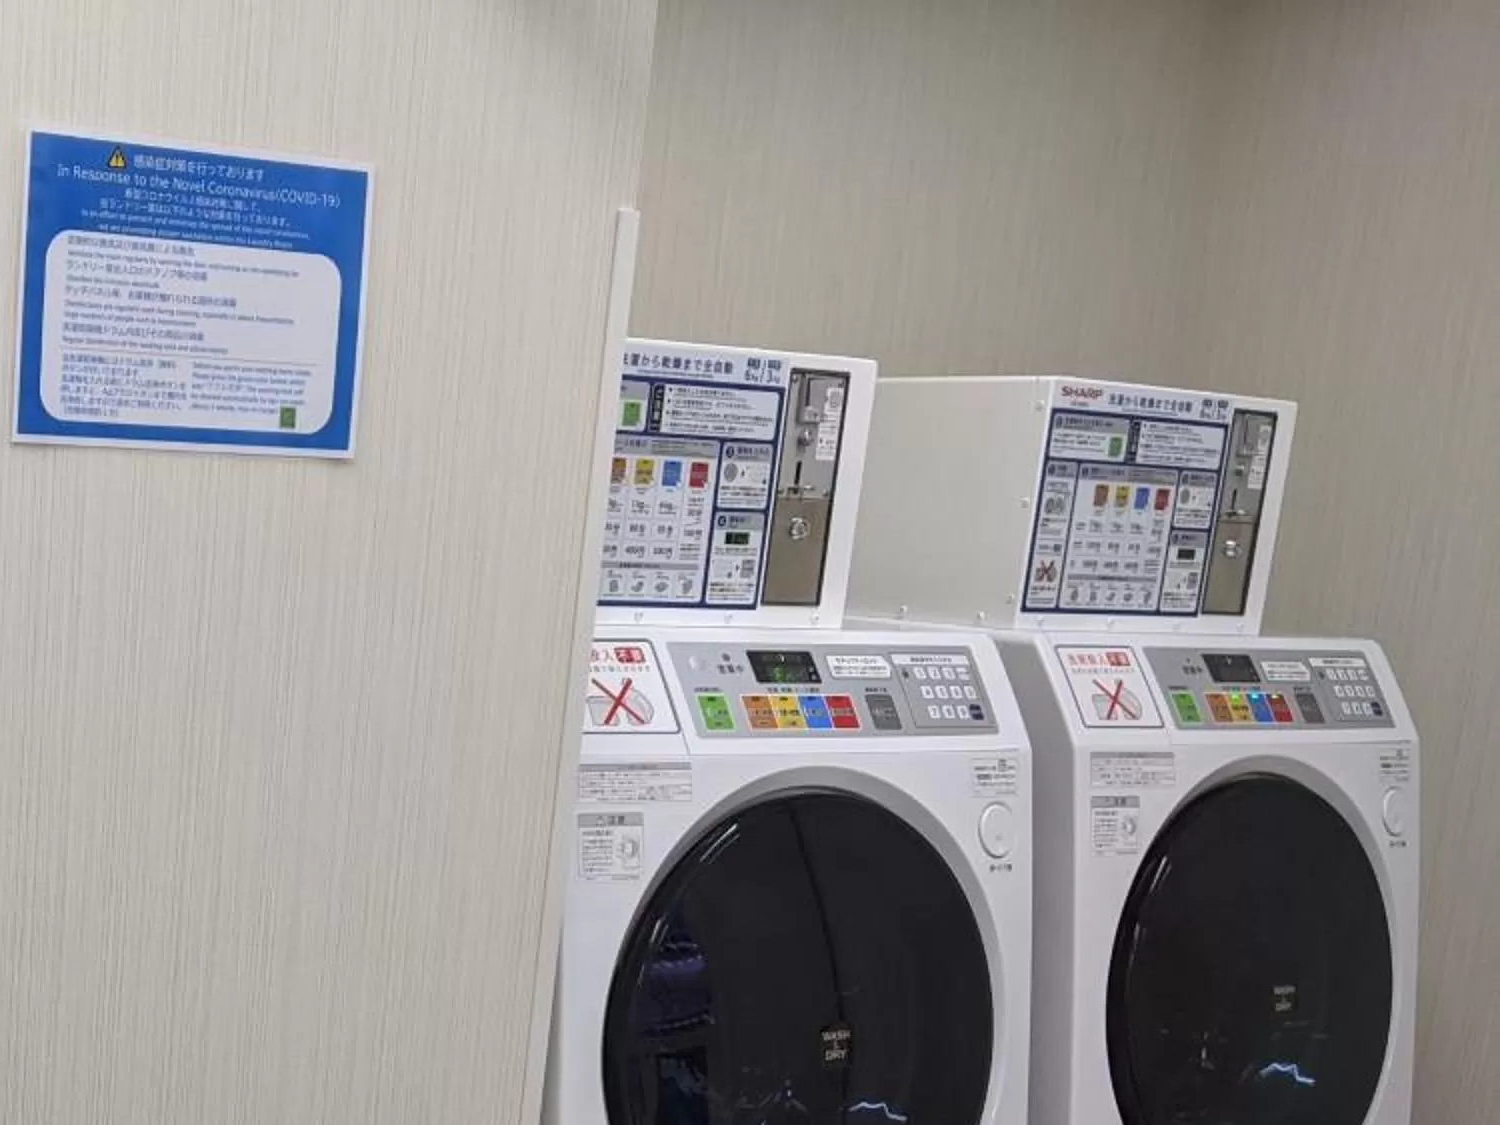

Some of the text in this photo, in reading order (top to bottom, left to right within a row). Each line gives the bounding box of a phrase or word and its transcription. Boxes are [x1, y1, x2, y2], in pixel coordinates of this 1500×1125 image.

[57, 163, 69, 177] In
[73, 165, 131, 186] Response
[134, 173, 147, 187] to
[150, 174, 170, 189] the
[172, 177, 206, 194] Novel
[1061, 386, 1104, 400] SHARP
[821, 1029, 851, 1041] WASH
[824, 1049, 848, 1061] DRY
